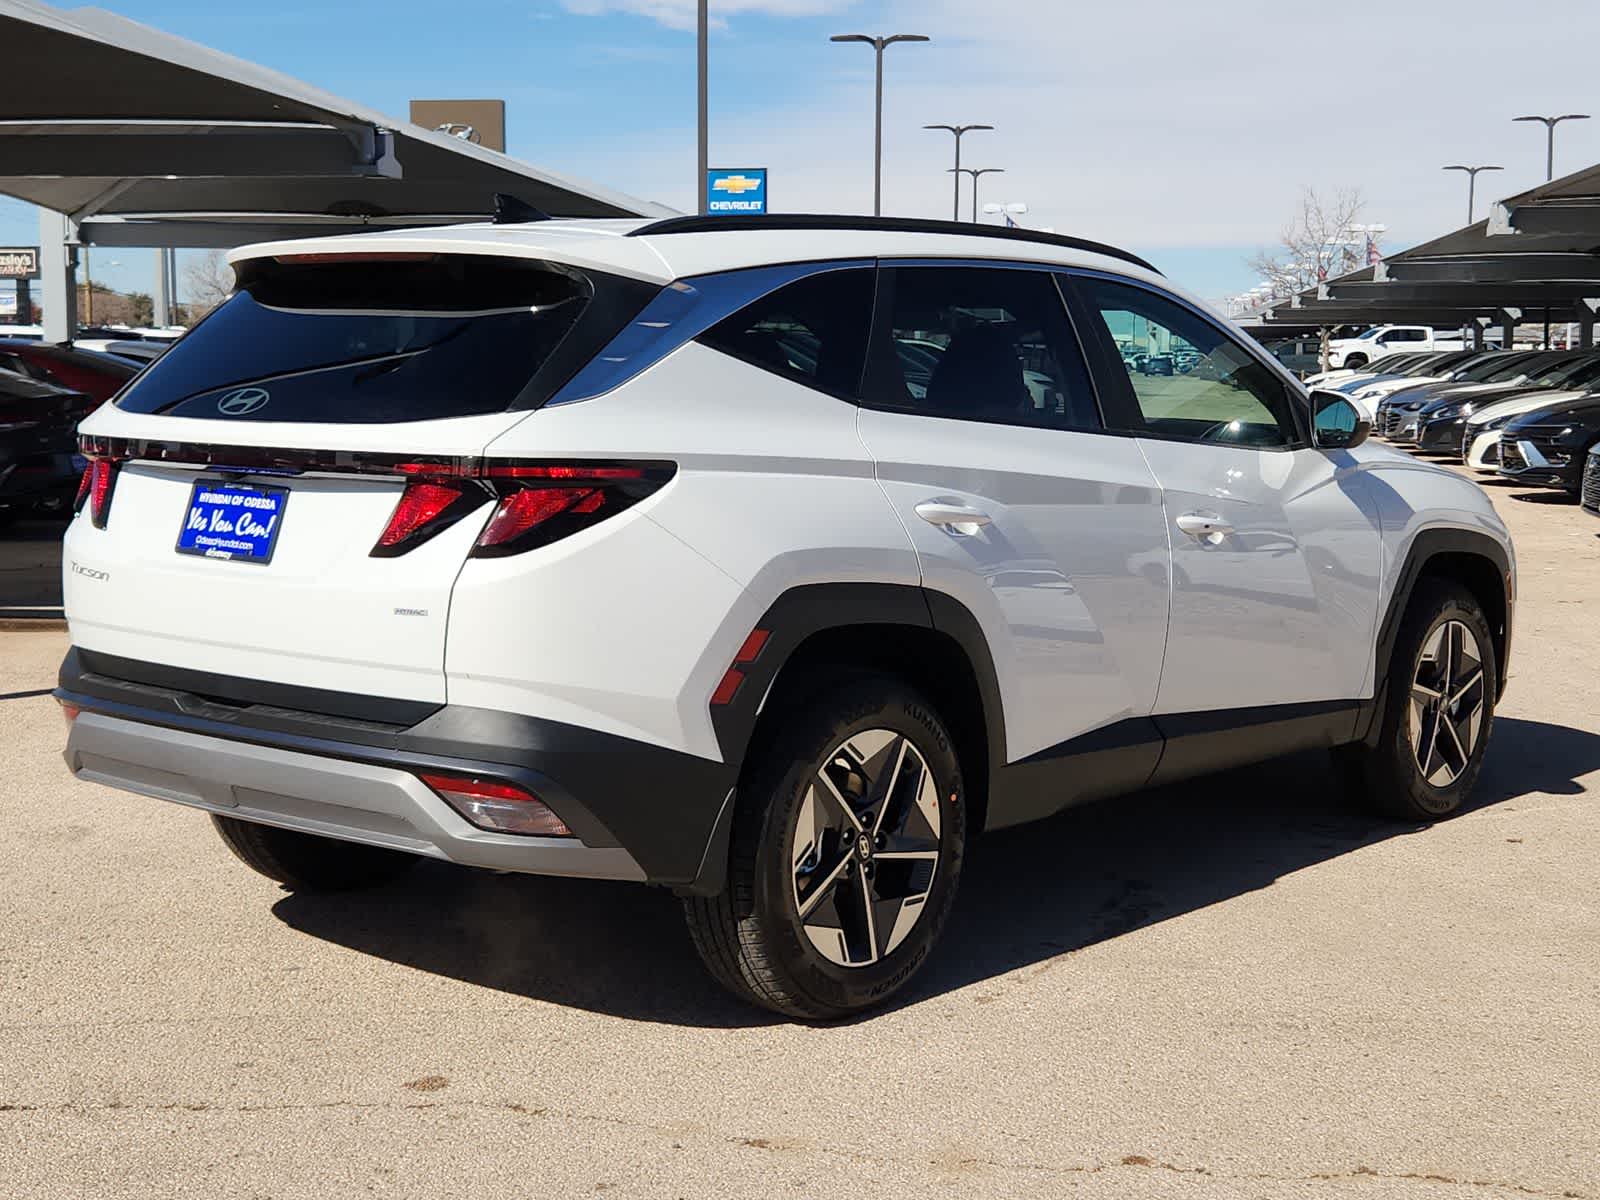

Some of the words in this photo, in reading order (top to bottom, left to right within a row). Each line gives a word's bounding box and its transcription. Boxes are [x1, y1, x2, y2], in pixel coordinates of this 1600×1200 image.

[709, 201, 763, 210] CHEVROLET
[199, 492, 231, 505] HYUNDAI
[231, 495, 245, 506] OF
[243, 498, 276, 510] ODESSA
[186, 507, 208, 531] Yes
[208, 509, 233, 532] You
[235, 512, 277, 538] Can!
[71, 560, 110, 581] Tucson
[903, 703, 950, 752] KUMHO
